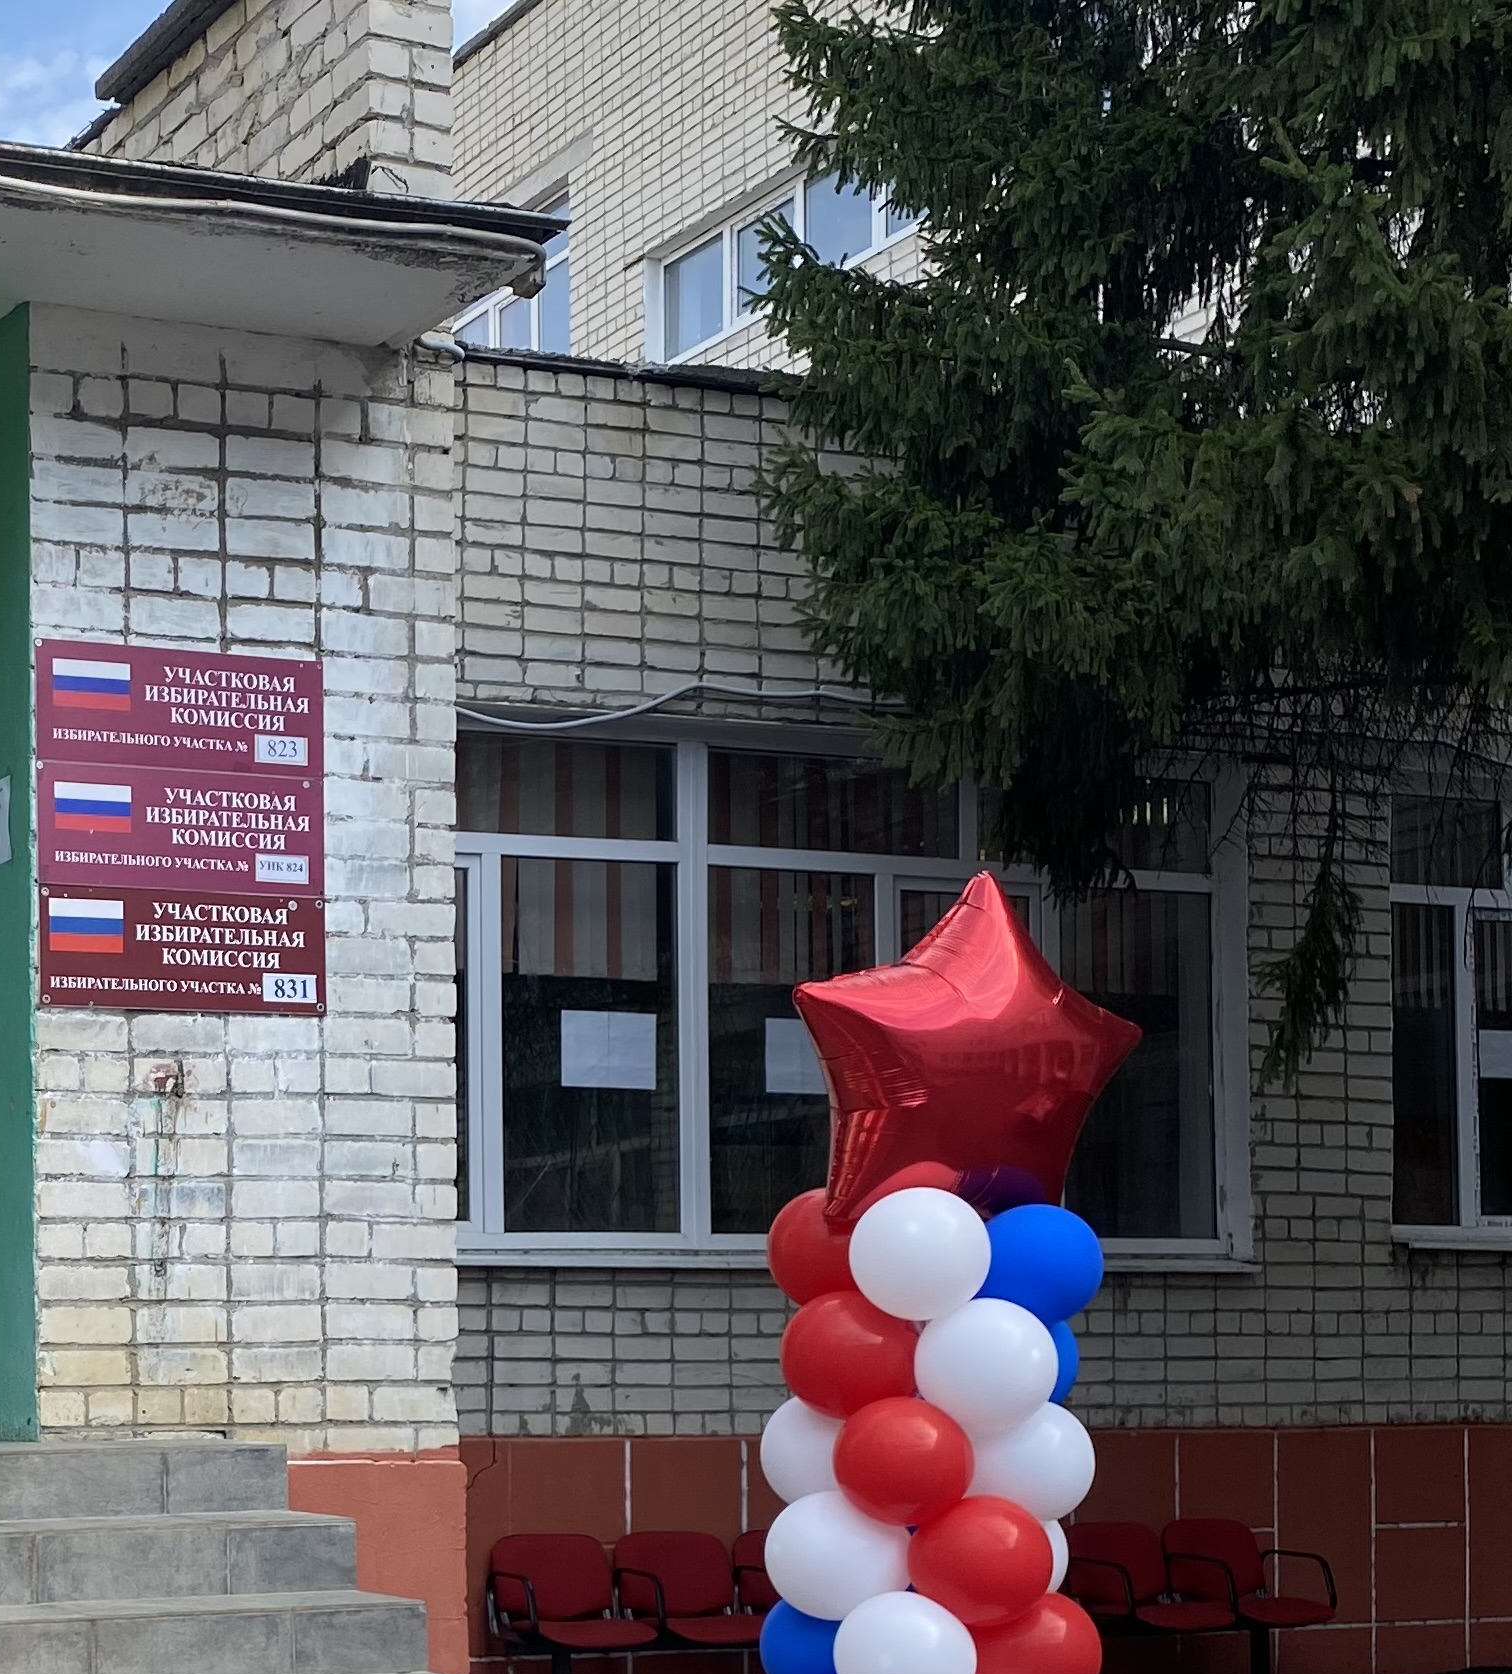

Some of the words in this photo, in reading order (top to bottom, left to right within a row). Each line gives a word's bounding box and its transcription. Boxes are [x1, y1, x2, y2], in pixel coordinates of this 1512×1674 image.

[163, 666, 295, 693] УЧАСТКОВАЯ
[145, 685, 309, 714] ИЗБИРАТЕЛЬНАЯ
[171, 707, 285, 732] КОМИССИЯ
[53, 729, 170, 747] ИЗБИРАТЕЛЬНОГО
[174, 736, 233, 751] УЧАСТКА
[235, 741, 248, 752] №
[267, 740, 298, 758] 823
[164, 788, 296, 811] УЧАСТКОВАЯ
[146, 807, 310, 832] ИЗБИРАТЕЛЬНАЯ
[171, 829, 286, 850] КОМИССИЯ
[55, 851, 172, 868] ИЗБИРАТЕЛЬНОГО
[175, 858, 233, 871] УЧАСТКА
[236, 861, 248, 872] №
[286, 863, 303, 873] 824
[153, 902, 288, 925] УЧАСТКОВАЯ
[136, 924, 305, 948] ИЗБИРАТЕЛЬНАЯ
[162, 948, 280, 969] КОМИССИЯ
[50, 976, 177, 991] ИЗБИРАТЕЛЬНОГО
[180, 981, 245, 995] УЧАСТКА
[247, 983, 262, 995] №
[274, 979, 309, 999] 831
